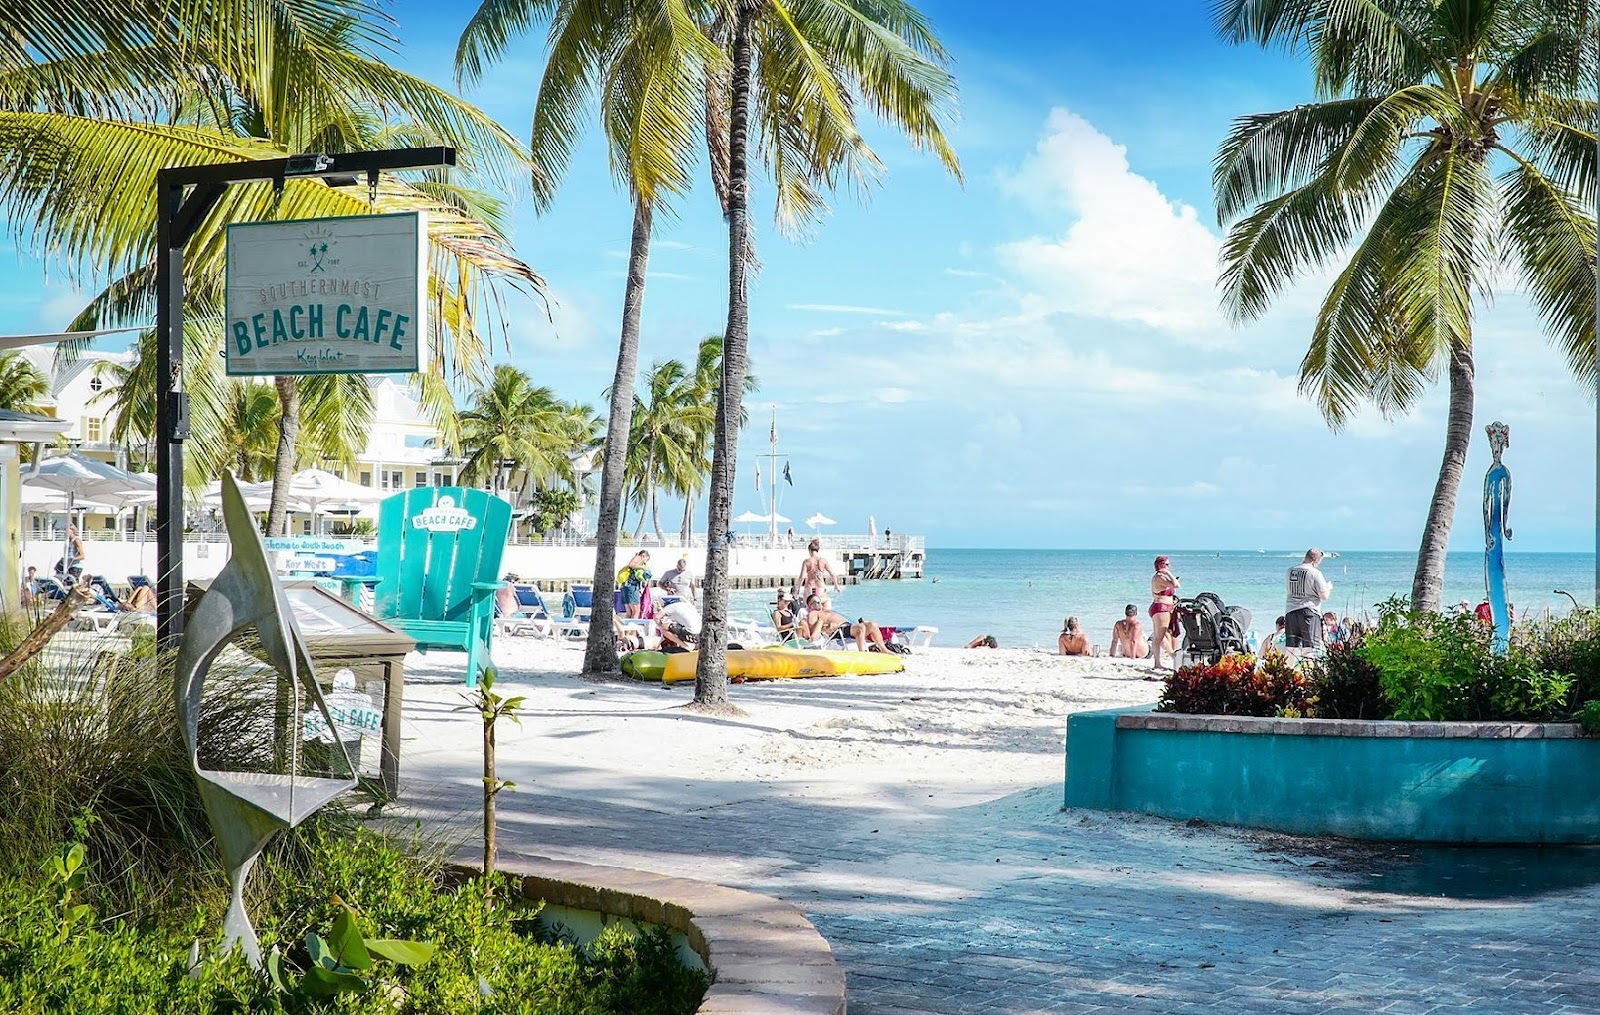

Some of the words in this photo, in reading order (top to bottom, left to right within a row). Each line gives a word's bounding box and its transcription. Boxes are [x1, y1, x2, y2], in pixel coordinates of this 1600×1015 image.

[260, 279, 381, 304] SOUTHERNMOST
[232, 304, 324, 357] BEACH
[336, 304, 410, 351] CAFE
[296, 347, 318, 368] Key
[319, 348, 343, 361] West
[415, 515, 446, 527] BEACH
[449, 515, 473, 528] CAFE
[321, 541, 345, 550] Beach
[349, 708, 379, 731] CAFE
